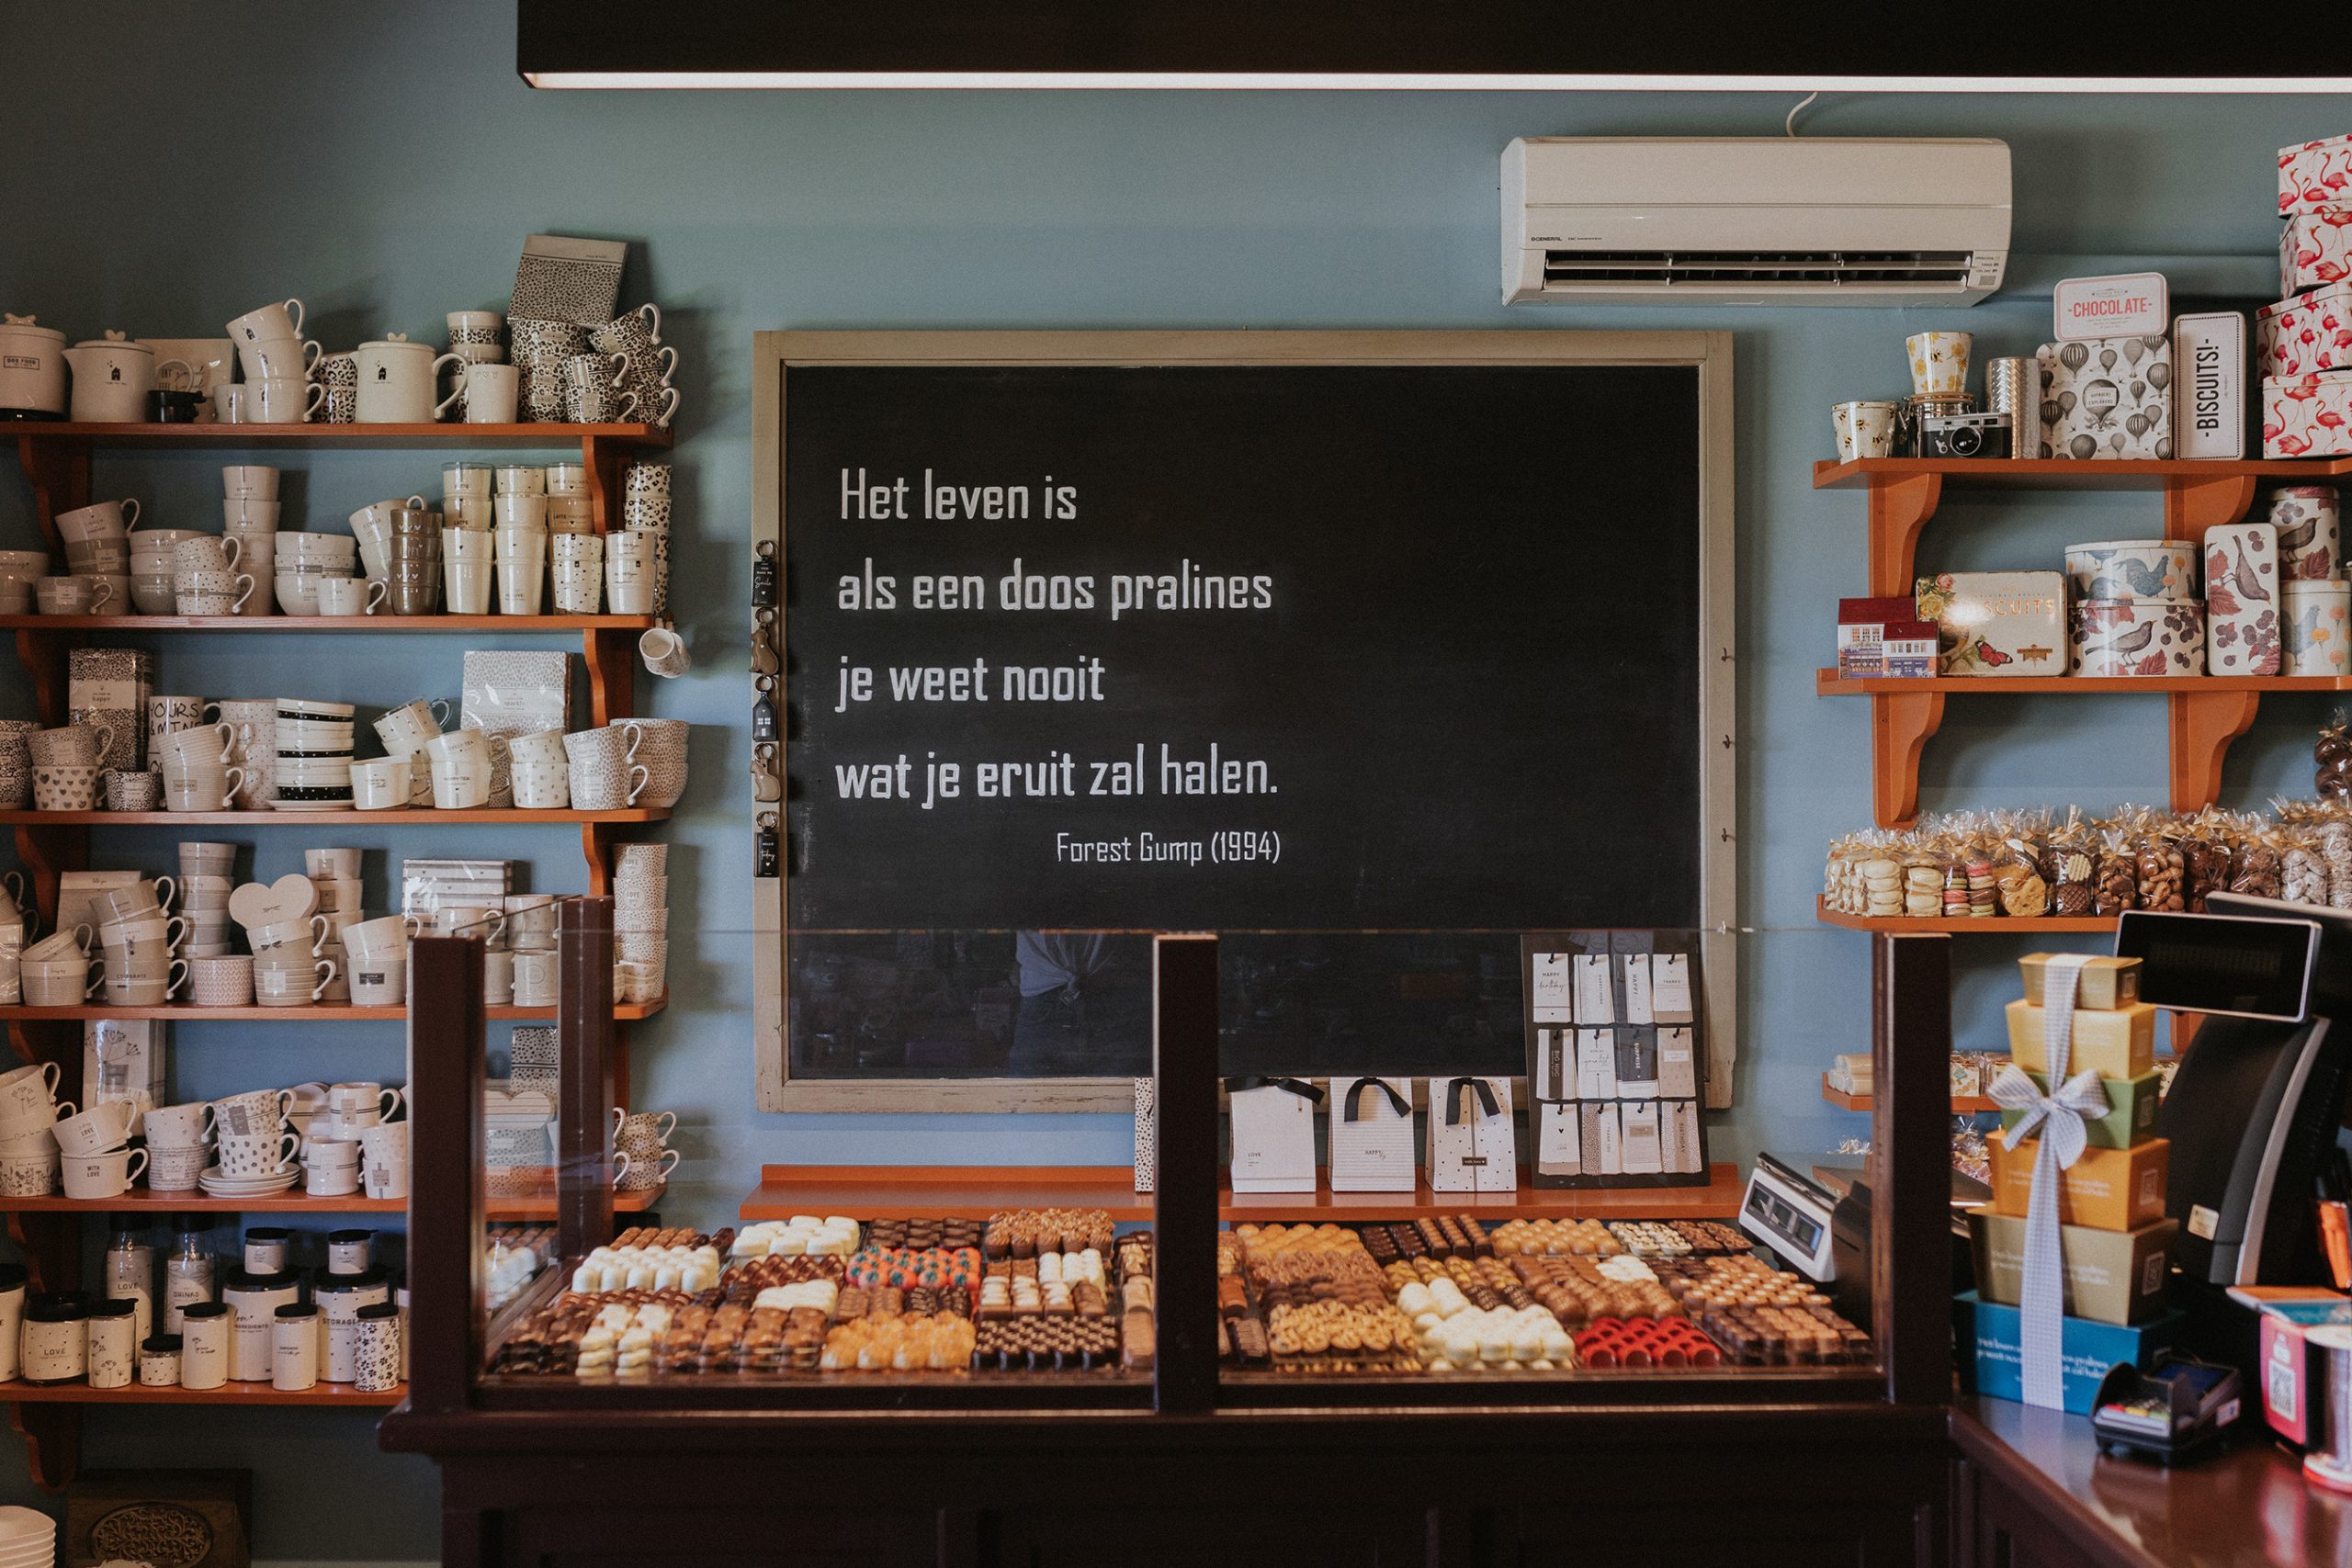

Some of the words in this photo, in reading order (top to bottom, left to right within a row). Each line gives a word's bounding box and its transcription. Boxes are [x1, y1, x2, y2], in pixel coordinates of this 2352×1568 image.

[841, 468, 910, 520] Het
[924, 468, 1029, 520] leven
[1045, 475, 1077, 520] is
[838, 557, 897, 610] als
[912, 575, 985, 610] een
[1000, 558, 1095, 611] doos
[1111, 558, 1272, 621] pralines
[834, 655, 873, 714] je
[888, 657, 989, 702] weet
[1003, 655, 1105, 702] nooit
[834, 753, 912, 799] wat
[921, 750, 960, 810] je
[977, 750, 1076, 797] eruit
[1089, 742, 1145, 795] zal
[1160, 742, 1278, 795] halen.
[1057, 832, 1132, 863] Forest
[1139, 831, 1203, 867] Gump
[1211, 830, 1281, 864] (1994)
[43, 1348, 66, 1356] LOVE
